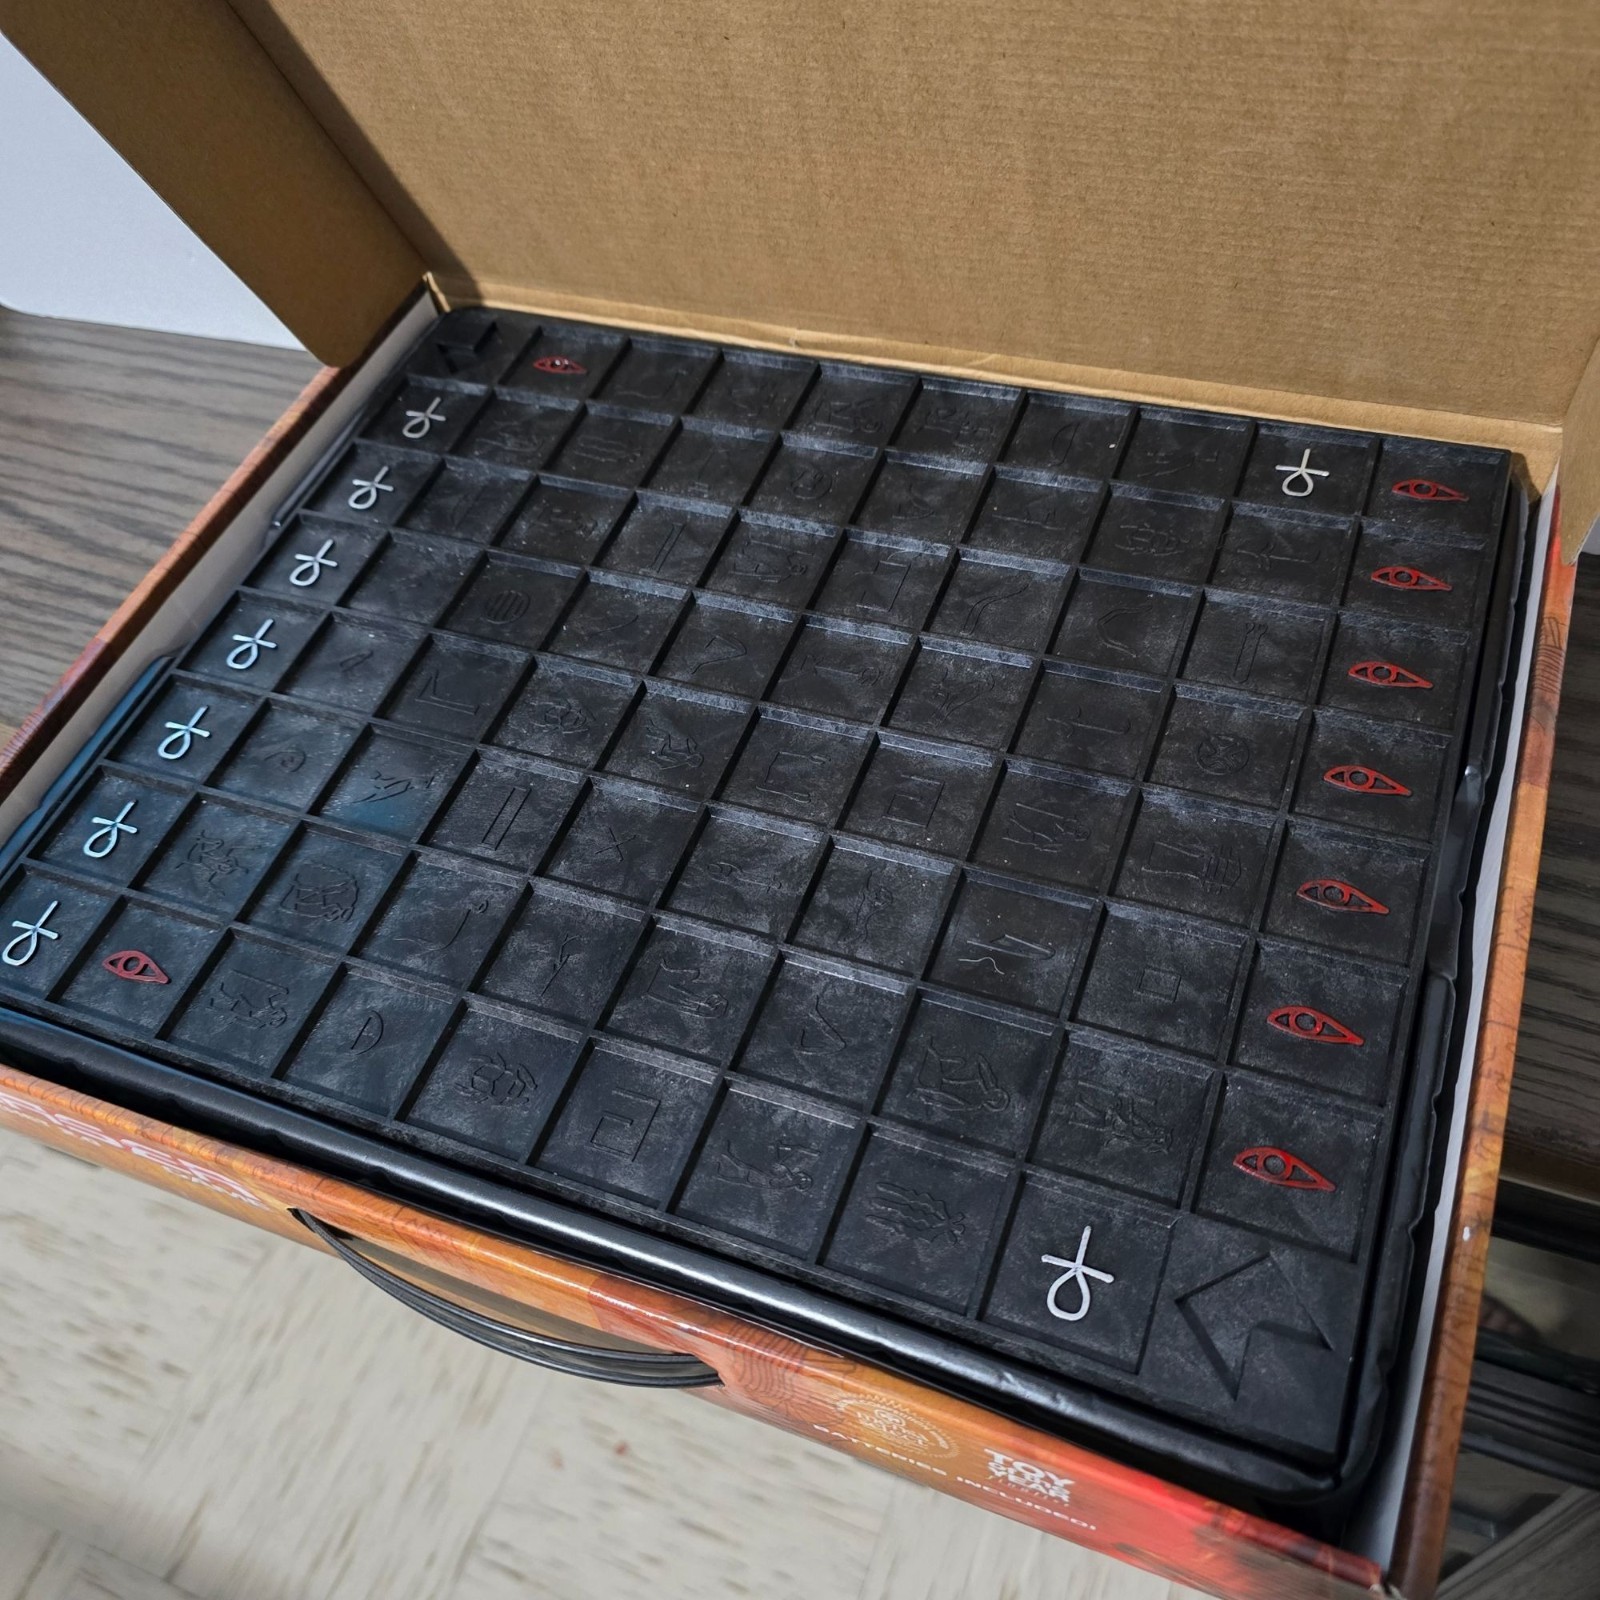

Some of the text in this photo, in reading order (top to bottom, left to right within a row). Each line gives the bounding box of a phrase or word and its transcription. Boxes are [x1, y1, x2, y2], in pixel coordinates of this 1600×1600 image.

[813, 1424, 947, 1476] BATTERIES
[956, 1476, 1097, 1531] INCLUDED!
[984, 1448, 1075, 1487] TOY
[988, 1467, 1070, 1502] YEAR
